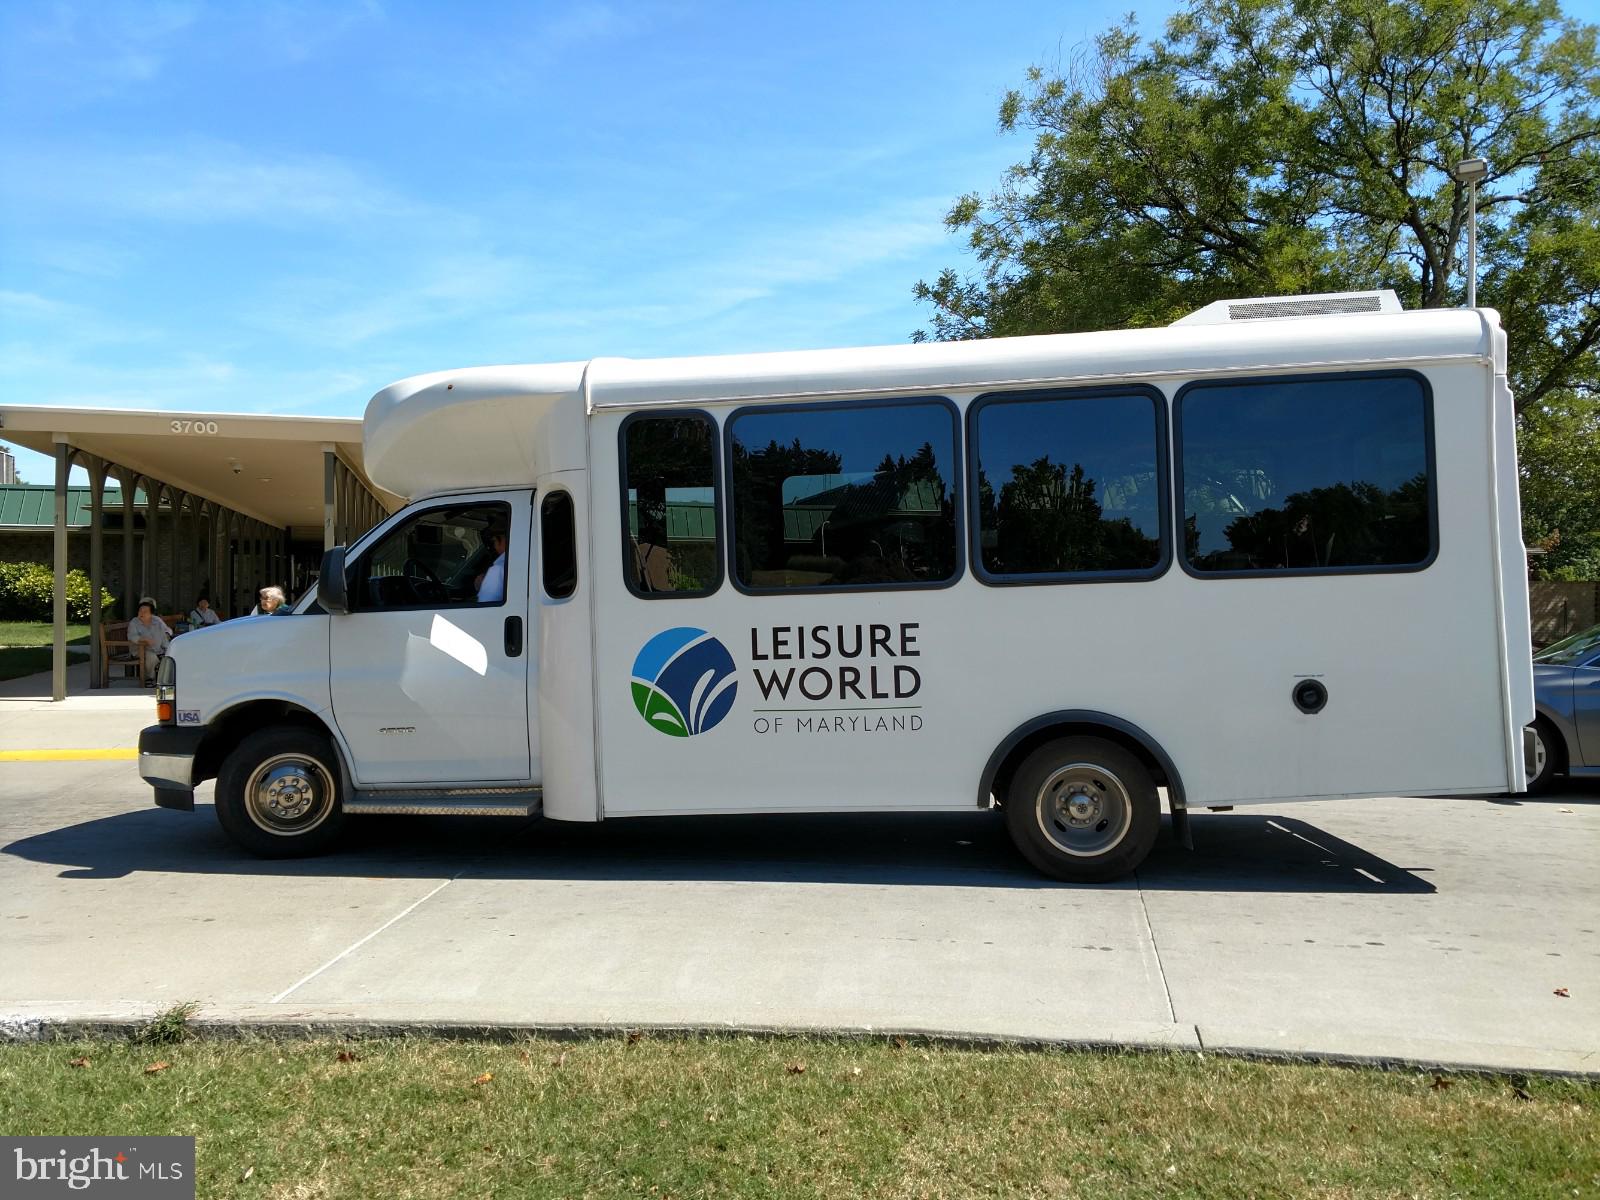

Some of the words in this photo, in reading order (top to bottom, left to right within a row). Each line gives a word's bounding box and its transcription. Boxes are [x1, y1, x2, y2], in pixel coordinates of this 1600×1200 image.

[171, 420, 218, 434] 3700
[751, 622, 921, 661] LEISURE
[752, 664, 922, 701] WORLD
[177, 712, 200, 723] USA
[753, 717, 783, 734] OF
[797, 714, 923, 734] MARYLAND
